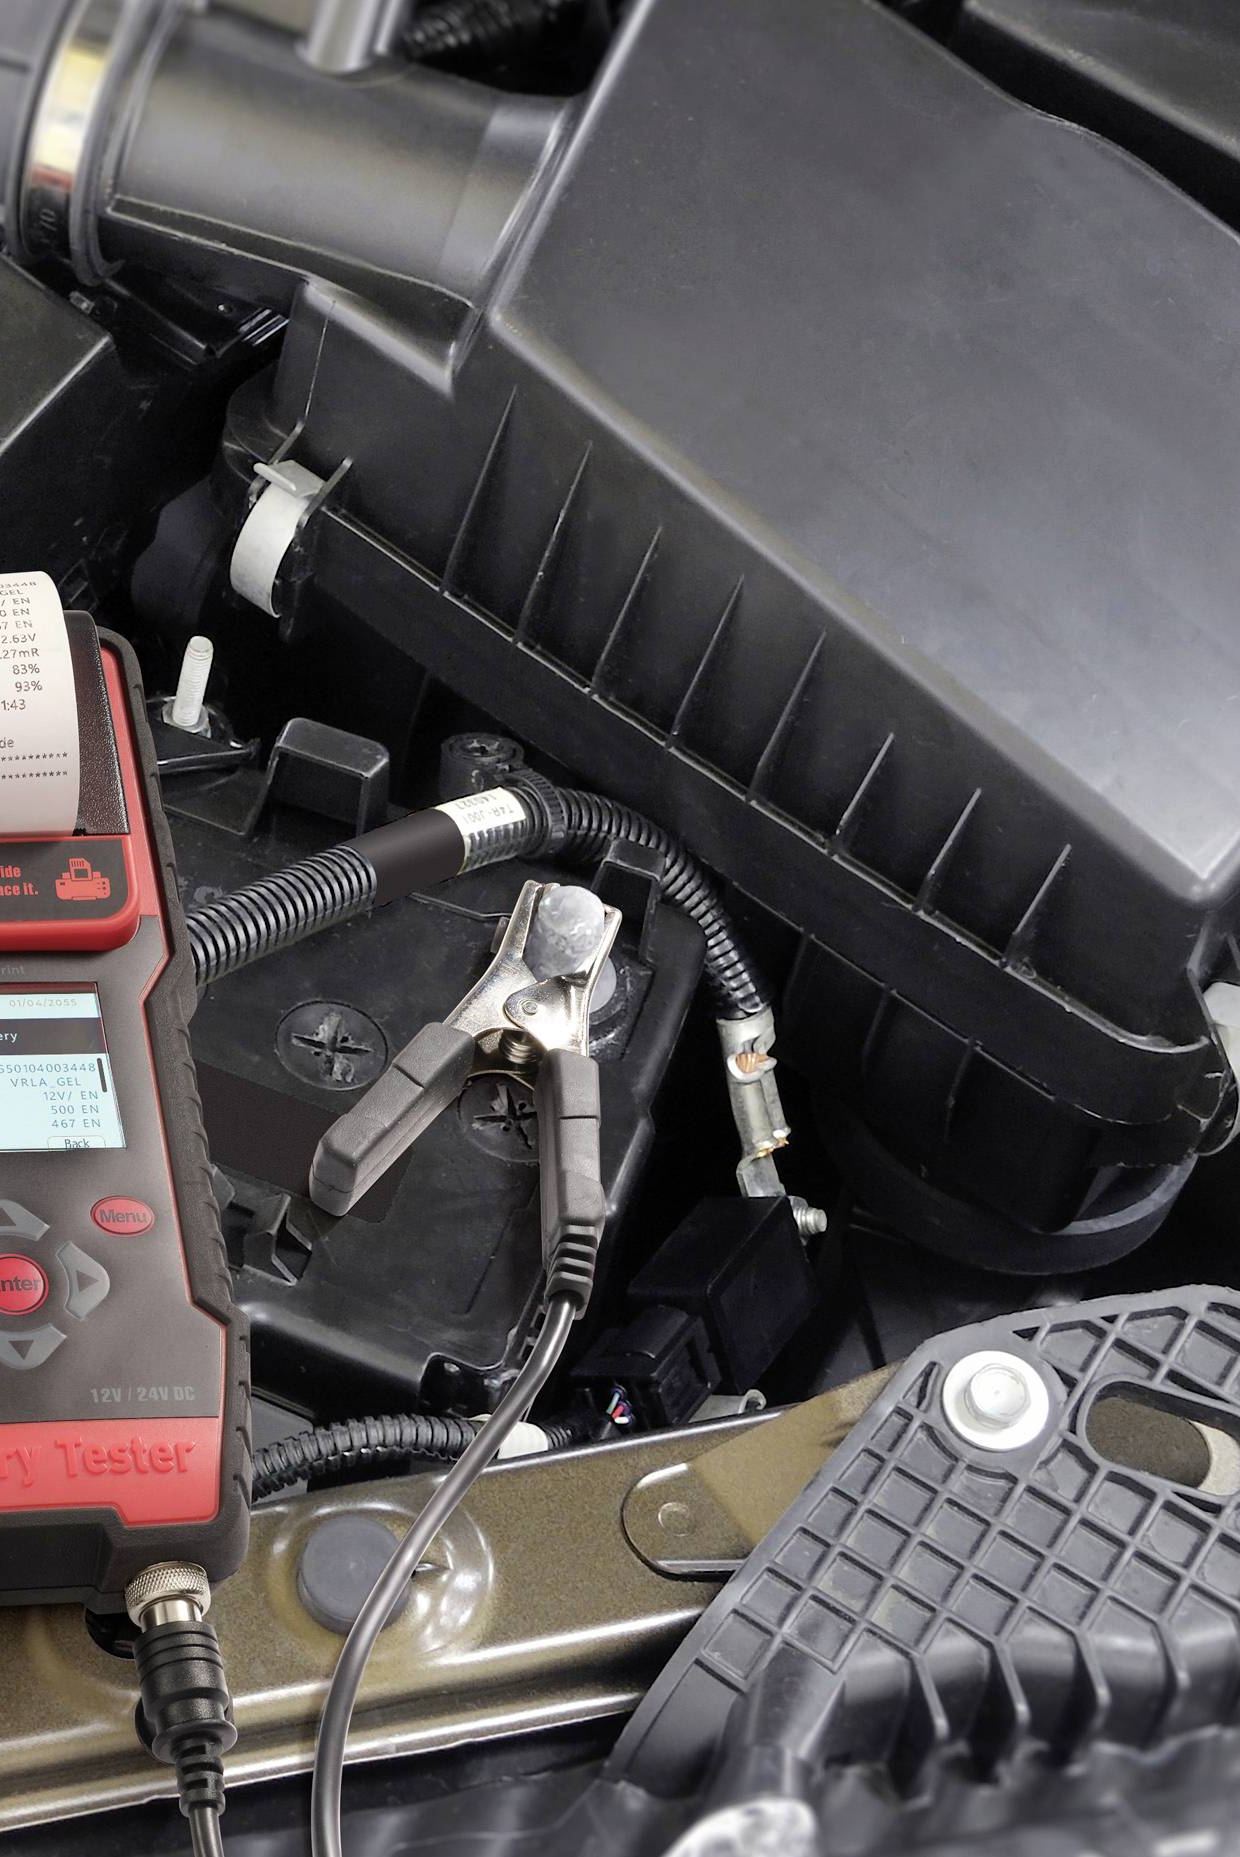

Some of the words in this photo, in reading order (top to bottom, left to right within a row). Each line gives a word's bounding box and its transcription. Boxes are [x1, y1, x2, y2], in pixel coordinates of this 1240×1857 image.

[12, 597, 31, 606] EN
[12, 607, 30, 617] EN
[15, 620, 33, 630] EN
[12, 664, 41, 676] 83%
[15, 680, 43, 693] 93%
[23, 882, 39, 896] it.
[8, 998, 78, 1009] 01/04/2055
[10, 1077, 82, 1088] VRLA_GEL
[43, 1091, 73, 1102] 12V/
[80, 1090, 99, 1100] EN
[51, 1105, 75, 1115] 500
[81, 1104, 100, 1114] EN
[51, 1119, 76, 1129] 467
[83, 1118, 101, 1128] EN
[64, 1138, 91, 1149] Back
[100, 1209, 148, 1224] Menu
[90, 1388, 123, 1404] 12V
[137, 1387, 170, 1403] 24V
[173, 1385, 196, 1401] DC
[55, 1435, 196, 1479] Tester
